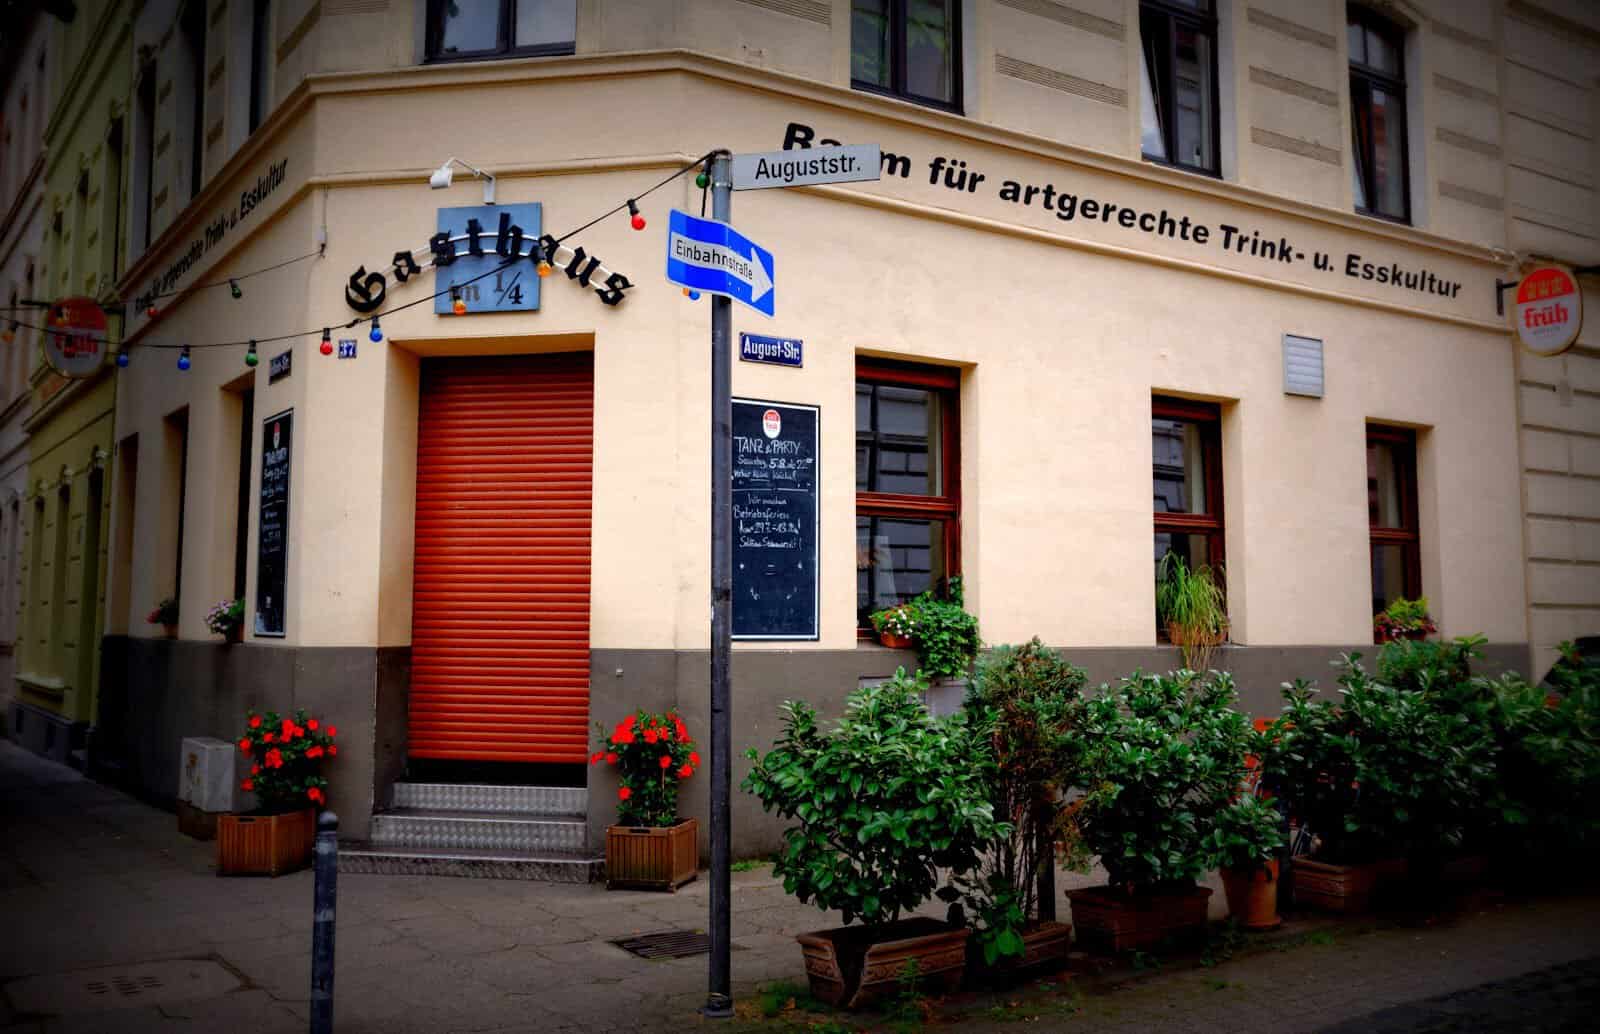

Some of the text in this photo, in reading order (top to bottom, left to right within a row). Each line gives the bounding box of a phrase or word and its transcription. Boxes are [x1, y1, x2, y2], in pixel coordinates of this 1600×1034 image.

[754, 153, 861, 182] Auguststr.
[783, 122, 1462, 299] Rm für artgerechte Trink- u. Esskultur
[345, 212, 634, 312] Gasthaus
[675, 239, 753, 281] Einbahnstraße
[1524, 303, 1568, 328] früh
[340, 342, 354, 357] 37
[744, 336, 800, 360] August-Str.
[771, 439, 800, 455] PARTY
